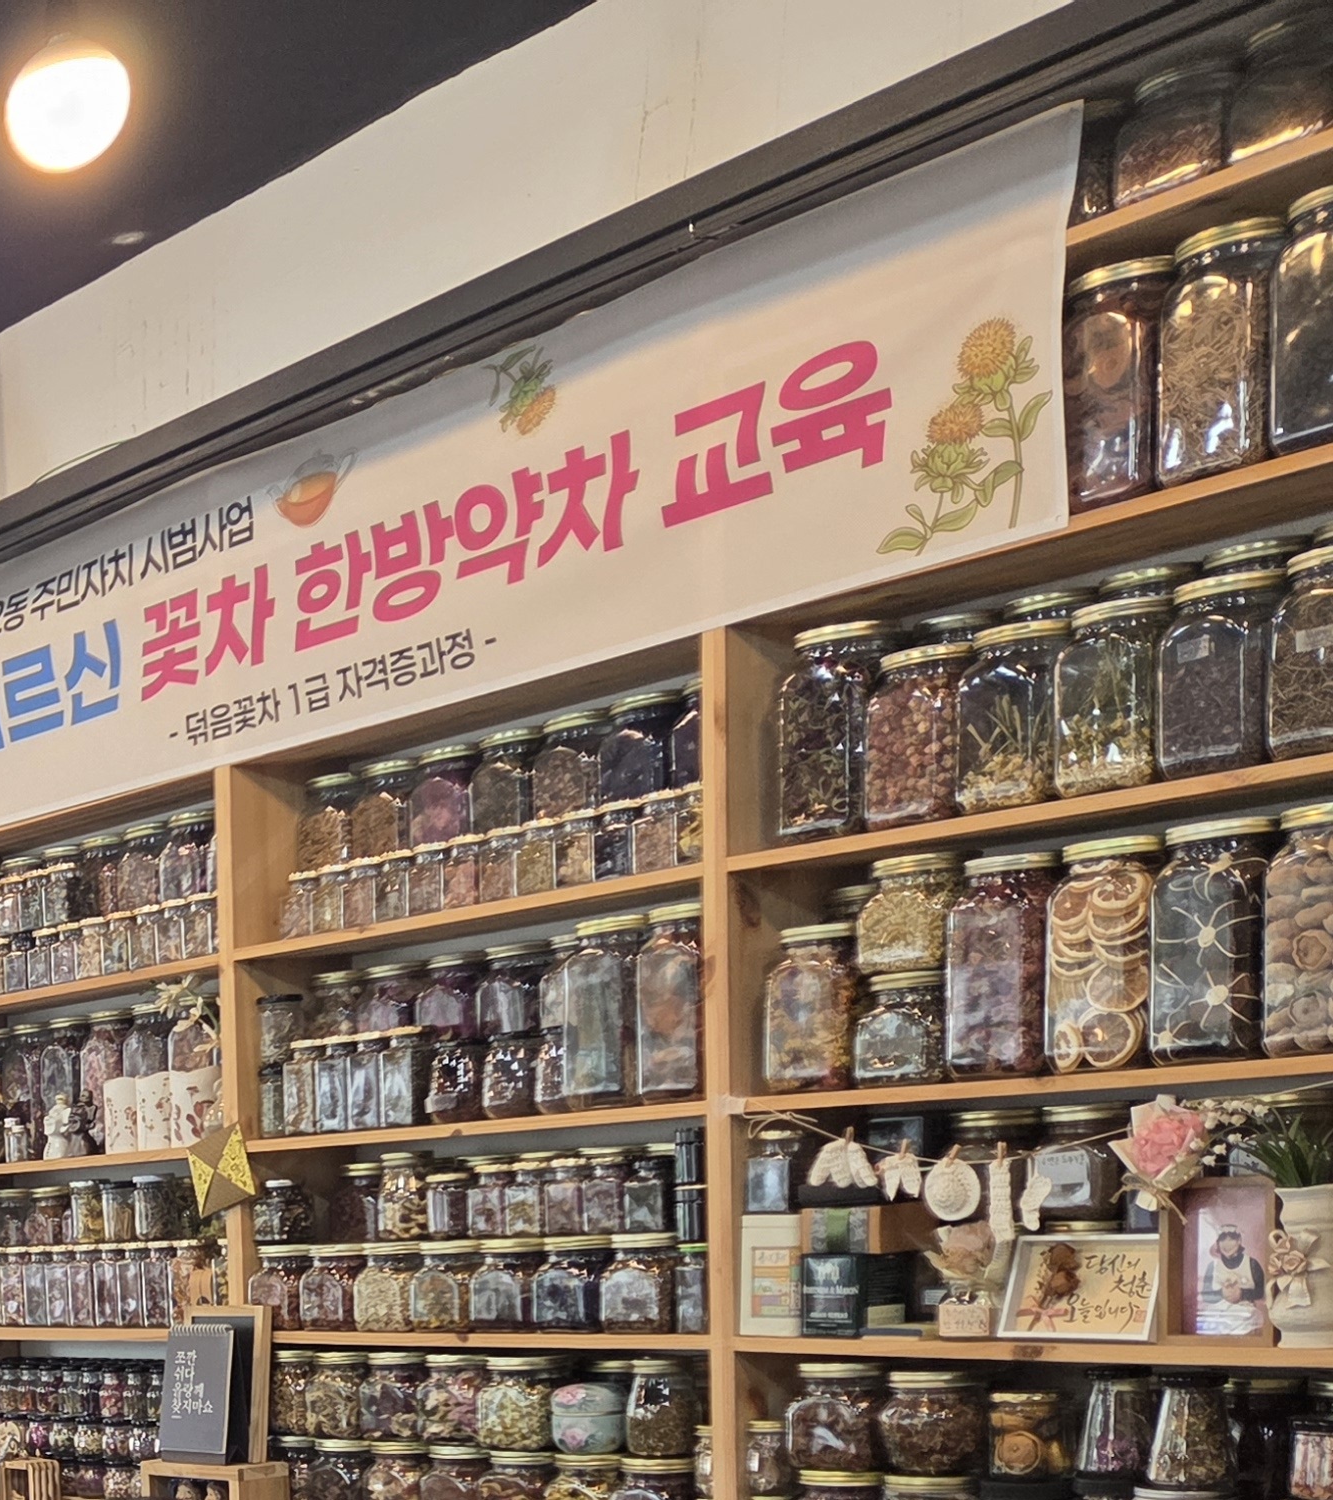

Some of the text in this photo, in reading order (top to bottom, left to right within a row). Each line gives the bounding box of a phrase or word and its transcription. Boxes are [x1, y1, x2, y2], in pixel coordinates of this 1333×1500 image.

[141, 563, 276, 702] 꽃차
[294, 429, 640, 652] 한방약차
[661, 340, 893, 528] 교육
[30, 542, 134, 620] 주민자치
[140, 495, 254, 581] 시범사업
[185, 687, 281, 746] 덖음꽃차
[288, 672, 331, 716] 1급
[336, 628, 476, 702] 자격증과정
[1084, 1252, 1141, 1276] 당신의
[1063, 1292, 1140, 1333] 오늘입니다
[173, 1365, 195, 1381] 쉬다
[171, 1398, 213, 1415] 찾지마쇼
